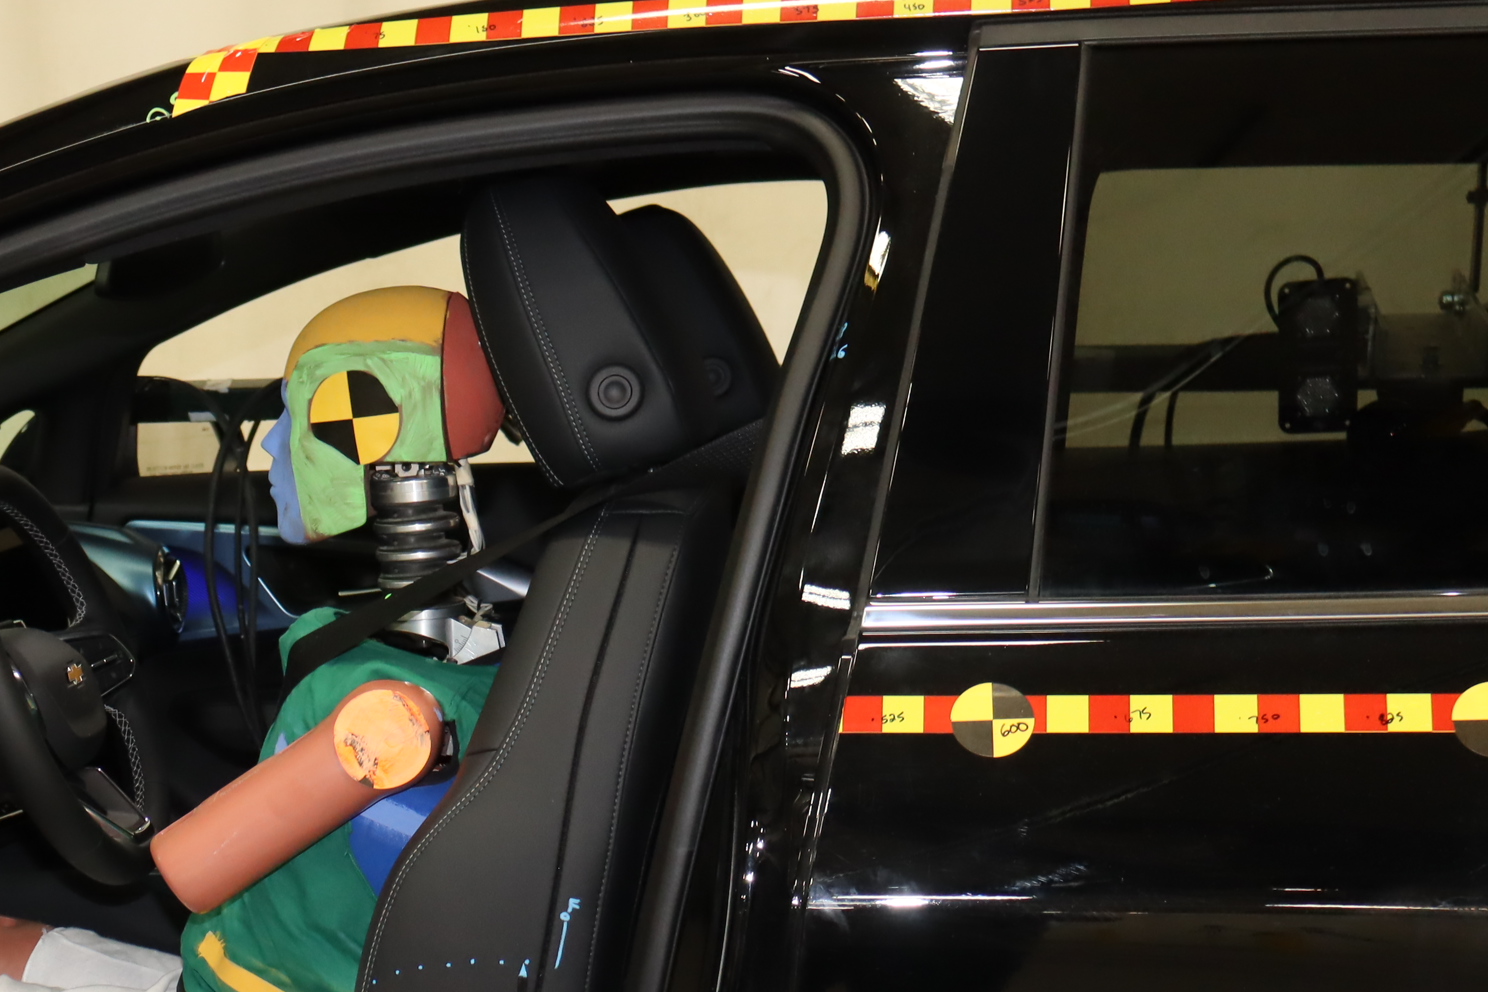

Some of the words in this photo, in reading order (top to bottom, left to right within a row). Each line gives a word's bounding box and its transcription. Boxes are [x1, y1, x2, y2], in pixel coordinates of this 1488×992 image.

[881, 711, 905, 725] 525
[1125, 707, 1152, 723] 675
[1248, 714, 1280, 725] 750
[1000, 722, 1029, 737] 600
[567, 897, 581, 913] F
